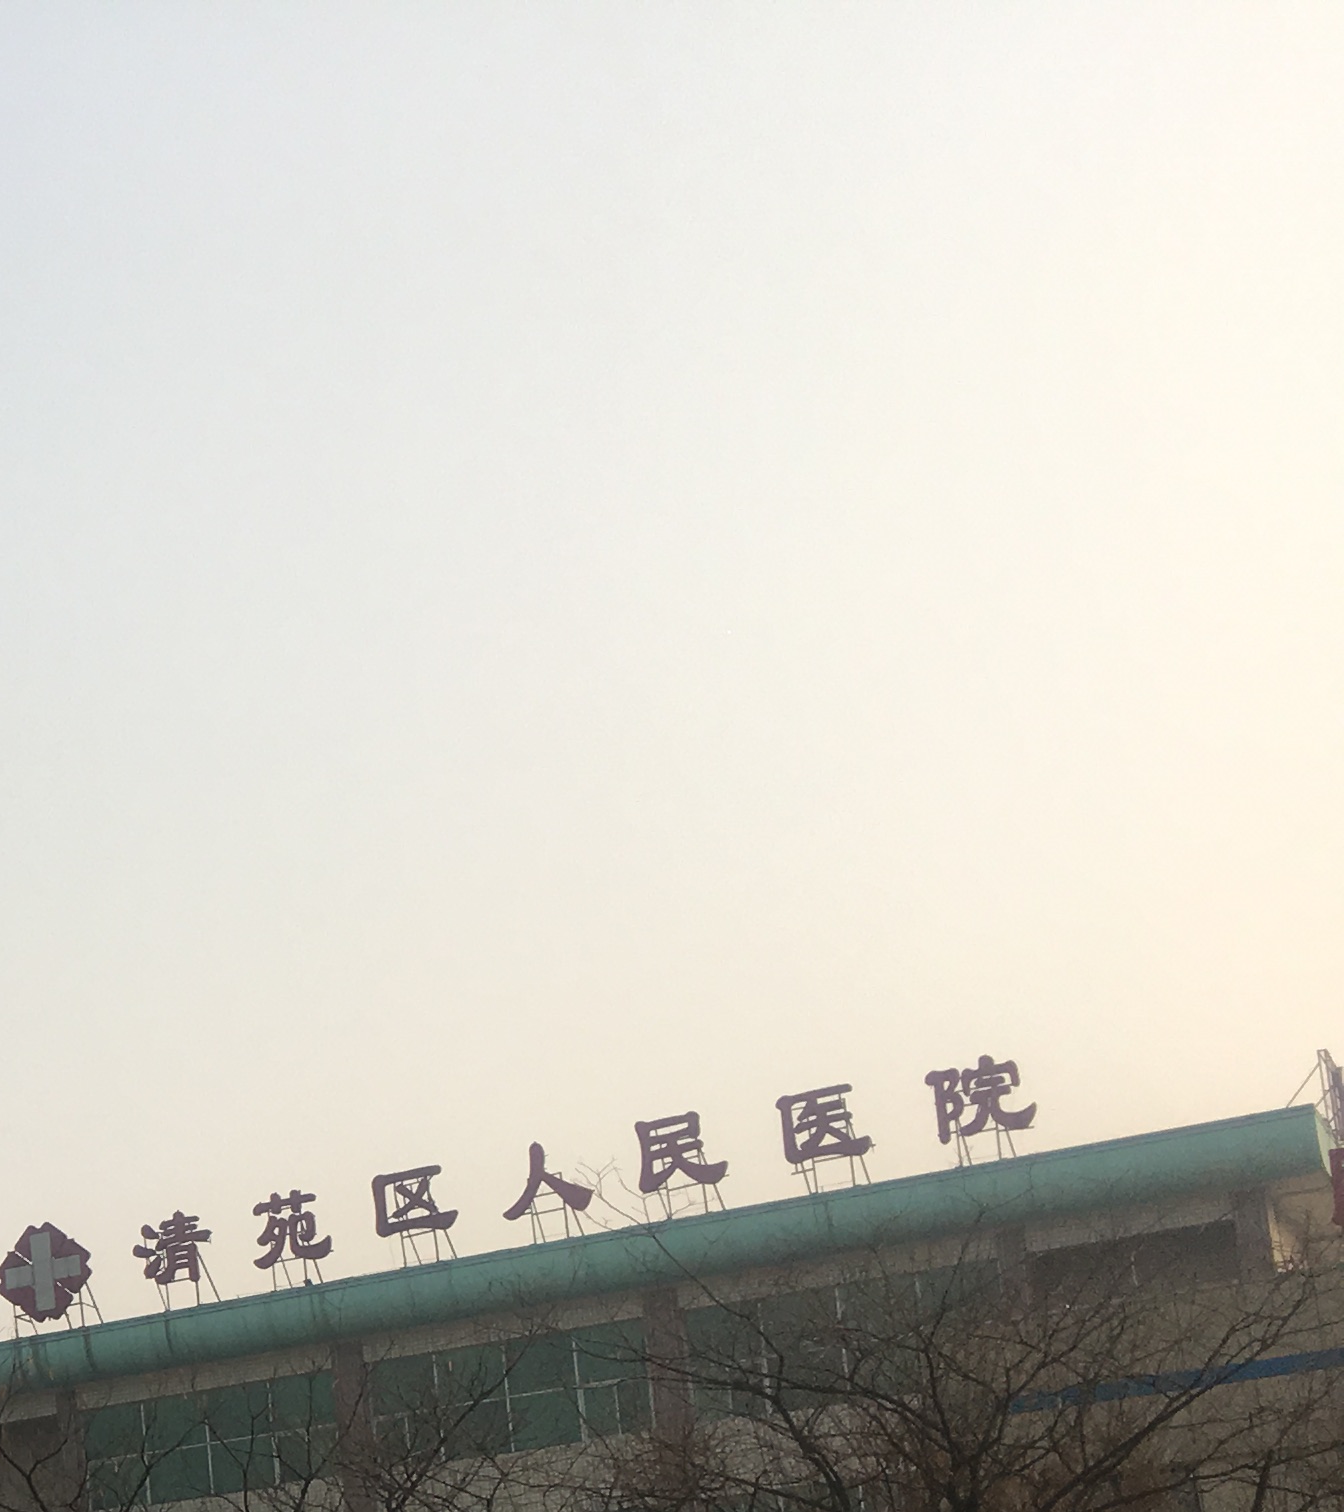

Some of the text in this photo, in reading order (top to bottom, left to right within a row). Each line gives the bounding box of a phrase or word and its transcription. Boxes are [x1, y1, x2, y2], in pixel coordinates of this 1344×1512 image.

[132, 1054, 1038, 1285] 清苑区人民医院
